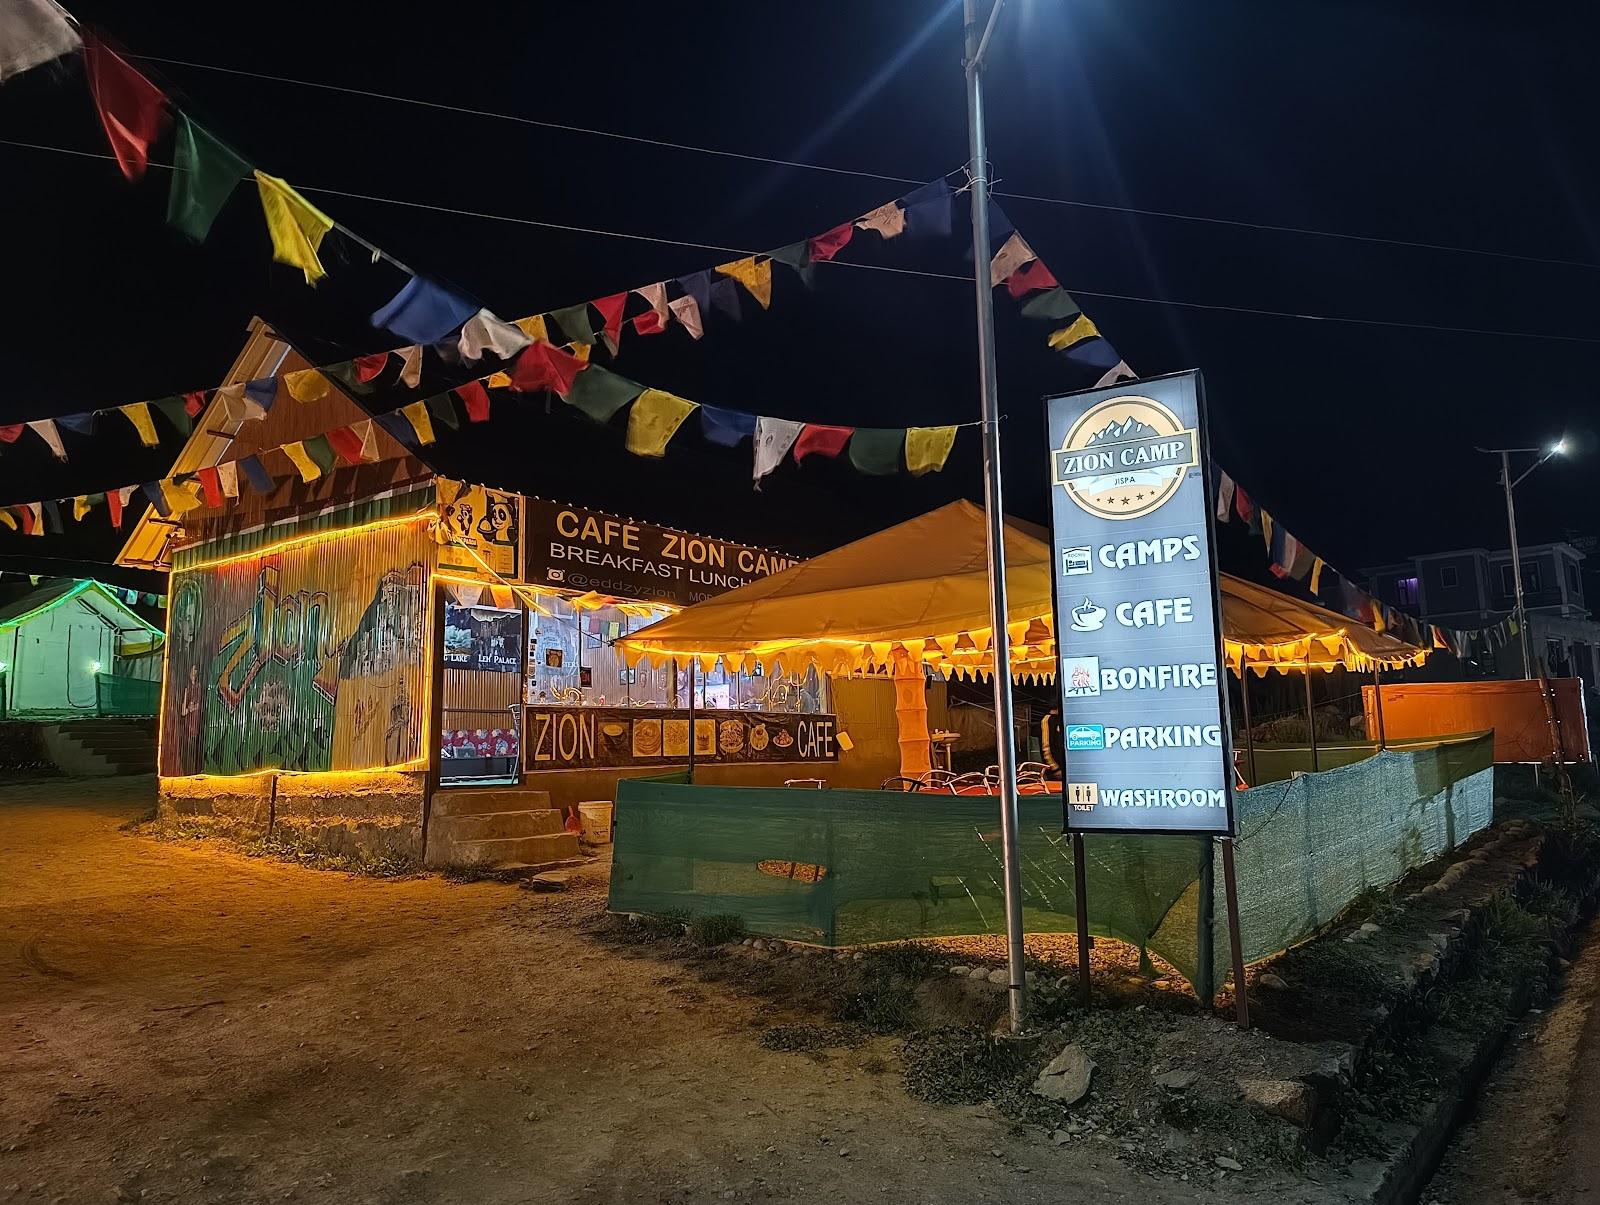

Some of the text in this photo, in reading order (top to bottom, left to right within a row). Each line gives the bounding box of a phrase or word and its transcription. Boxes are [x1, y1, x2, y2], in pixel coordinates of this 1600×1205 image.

[1063, 441, 1185, 475] ZION CAMP
[1114, 476, 1136, 486] JISPA
[556, 510, 640, 551] CAFÉ
[661, 533, 725, 568] ZION
[1098, 535, 1201, 570] CAMPS
[550, 542, 684, 580] BREAKFAST
[568, 573, 677, 599] @eddzyzion
[1115, 597, 1194, 628] CAFE
[1100, 663, 1217, 691] BONFIRE
[535, 713, 834, 761] ZION CAFE
[1103, 725, 1222, 750] PARKING
[1073, 804, 1095, 812] TOILET
[1099, 788, 1225, 809] WASHROOM
